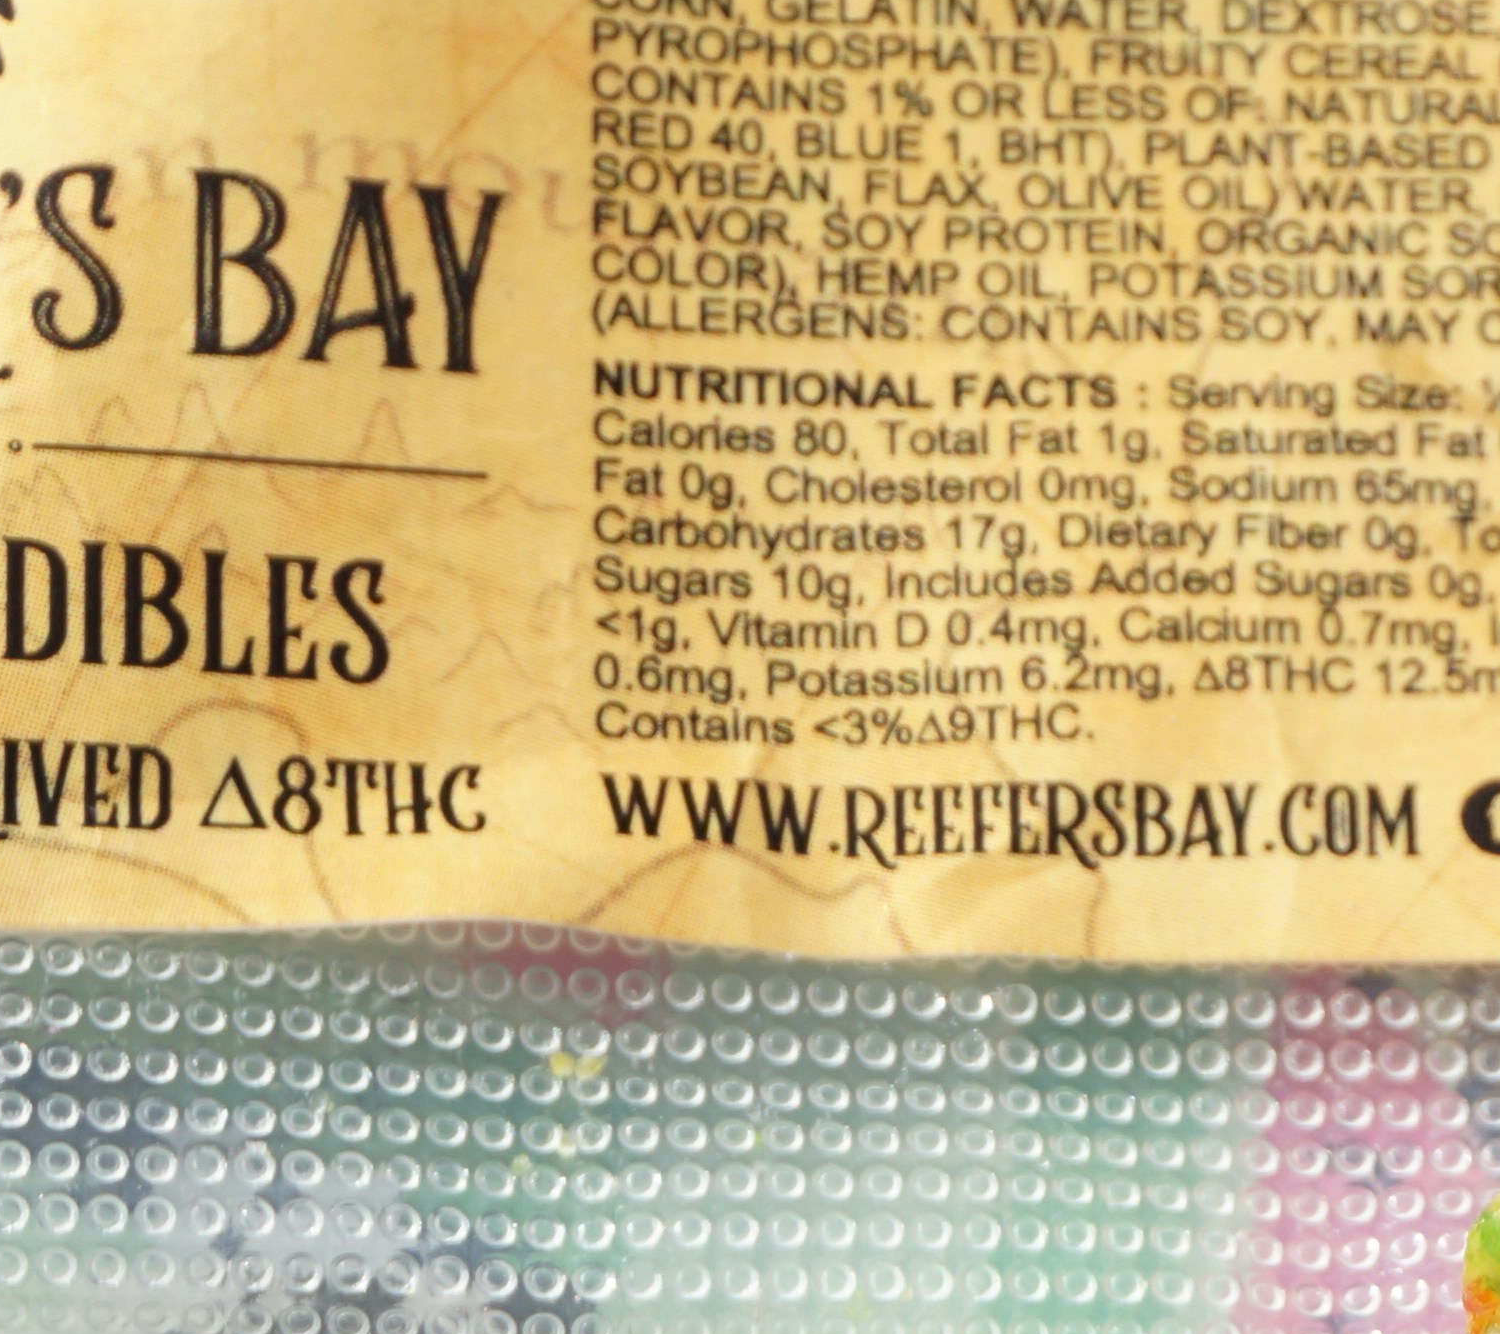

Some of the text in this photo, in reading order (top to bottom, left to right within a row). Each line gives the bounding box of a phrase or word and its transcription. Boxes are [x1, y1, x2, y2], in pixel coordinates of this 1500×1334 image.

[1090, 37, 1267, 79] FRUITY
[1284, 41, 1485, 83] CEREAL
[591, 62, 848, 114] CONTAINS
[867, 78, 935, 117] 1%
[952, 80, 1025, 118] OR
[1043, 84, 1169, 122] LESS
[592, 107, 695, 151] RED
[709, 117, 779, 164] 40,
[796, 120, 926, 164] BLUE
[944, 126, 982, 170] 1,
[1145, 129, 1493, 171] PLANT-BASED
[592, 152, 846, 210] SOYBEAN,
[865, 167, 998, 214] FLAX,
[1017, 172, 1165, 212] OLIVE
[593, 197, 804, 253] FLAVOR,
[821, 212, 926, 254] SOY
[943, 217, 1180, 260] PROTEIN,
[1198, 219, 1430, 259] ORGANIC
[188, 165, 508, 375] BAY
[815, 255, 961, 296] HEMP
[977, 261, 1072, 304] OIL,
[1089, 261, 1385, 302] POTASSIUM
[593, 289, 926, 340] (ALLERGENS:
[940, 303, 1204, 344] CONTAINS
[1219, 305, 1338, 349] SOY,
[1356, 307, 1458, 345] MAY
[593, 359, 934, 410] NUTRITIONAL
[952, 371, 1118, 411] FACTS
[1168, 373, 1337, 418] Serving
[1354, 371, 1465, 413] Size:
[592, 407, 776, 455] Calories
[792, 416, 861, 463] 80,
[878, 417, 989, 457] Total
[1008, 418, 1080, 457] Fat
[1099, 420, 1163, 465] 1g,
[1181, 417, 1399, 459] Saturated
[1415, 422, 1487, 460] Fat
[592, 455, 665, 501] Fat
[678, 462, 748, 512] 0g,
[764, 465, 1023, 505] Cholesterol
[1037, 466, 1150, 512] 0mg,
[1168, 464, 1339, 505] Sodium
[1354, 467, 1493, 515] 65mg,
[592, 504, 928, 561] Carbohydrates
[945, 514, 1040, 560] 17g,
[1057, 511, 1218, 557] Dietary
[1234, 512, 1351, 551] Fiber
[1363, 515, 1433, 562] 0g,
[592, 553, 754, 605] Sugars
[771, 561, 867, 610] 10g,
[883, 559, 1075, 599] Includes
[1088, 556, 1238, 598] Added
[1253, 557, 1414, 608] Sugars
[1426, 561, 1497, 609] 0g,
[595, 606, 692, 654] <1g,
[705, 605, 879, 650] Vitamin
[895, 609, 930, 649] D
[945, 605, 1102, 655] 0.4mg,
[1117, 603, 1302, 647] Calcium
[1316, 604, 1473, 655] 0.7mg,
[592, 650, 749, 705] 0.6mg,
[765, 655, 1006, 699] Potassium
[1018, 652, 1178, 701] 6.2mg,
[594, 698, 797, 745] Contains
[599, 772, 1422, 869] WWW.REEFERSBAY.COM
